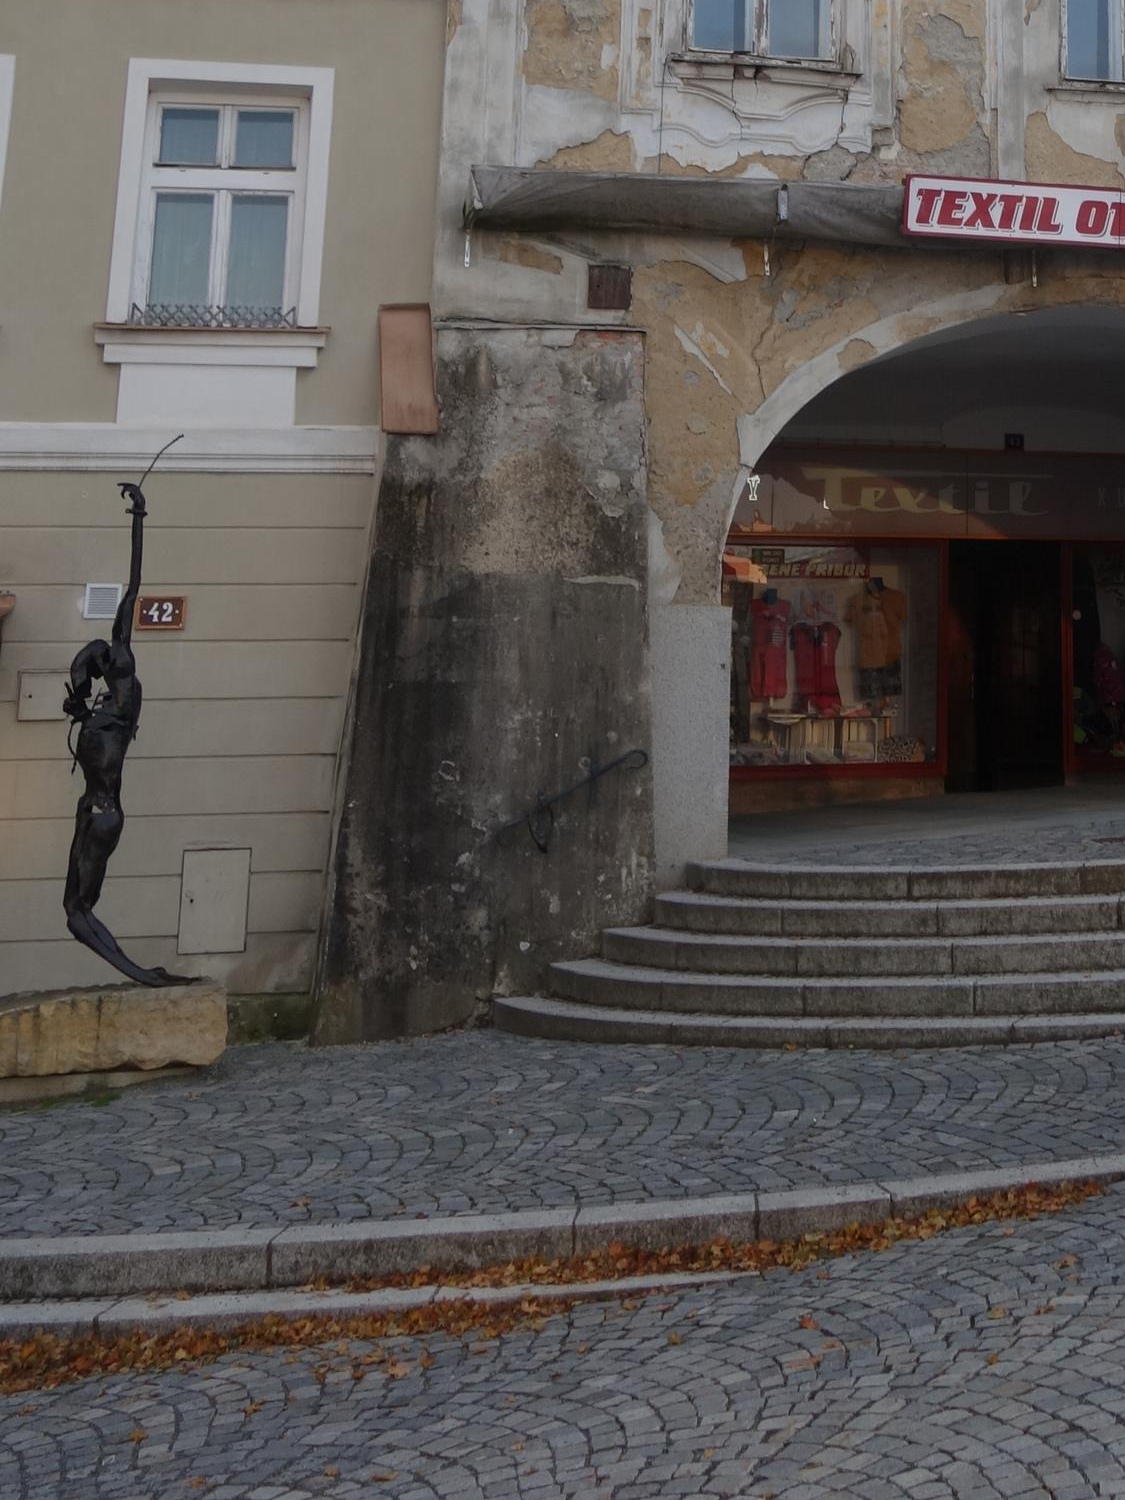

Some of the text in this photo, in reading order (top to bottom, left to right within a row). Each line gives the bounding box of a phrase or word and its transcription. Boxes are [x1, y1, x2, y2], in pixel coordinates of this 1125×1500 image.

[914, 187, 1063, 234] TEXTIL
[800, 465, 1055, 516] Textil
[148, 602, 173, 622] 42
